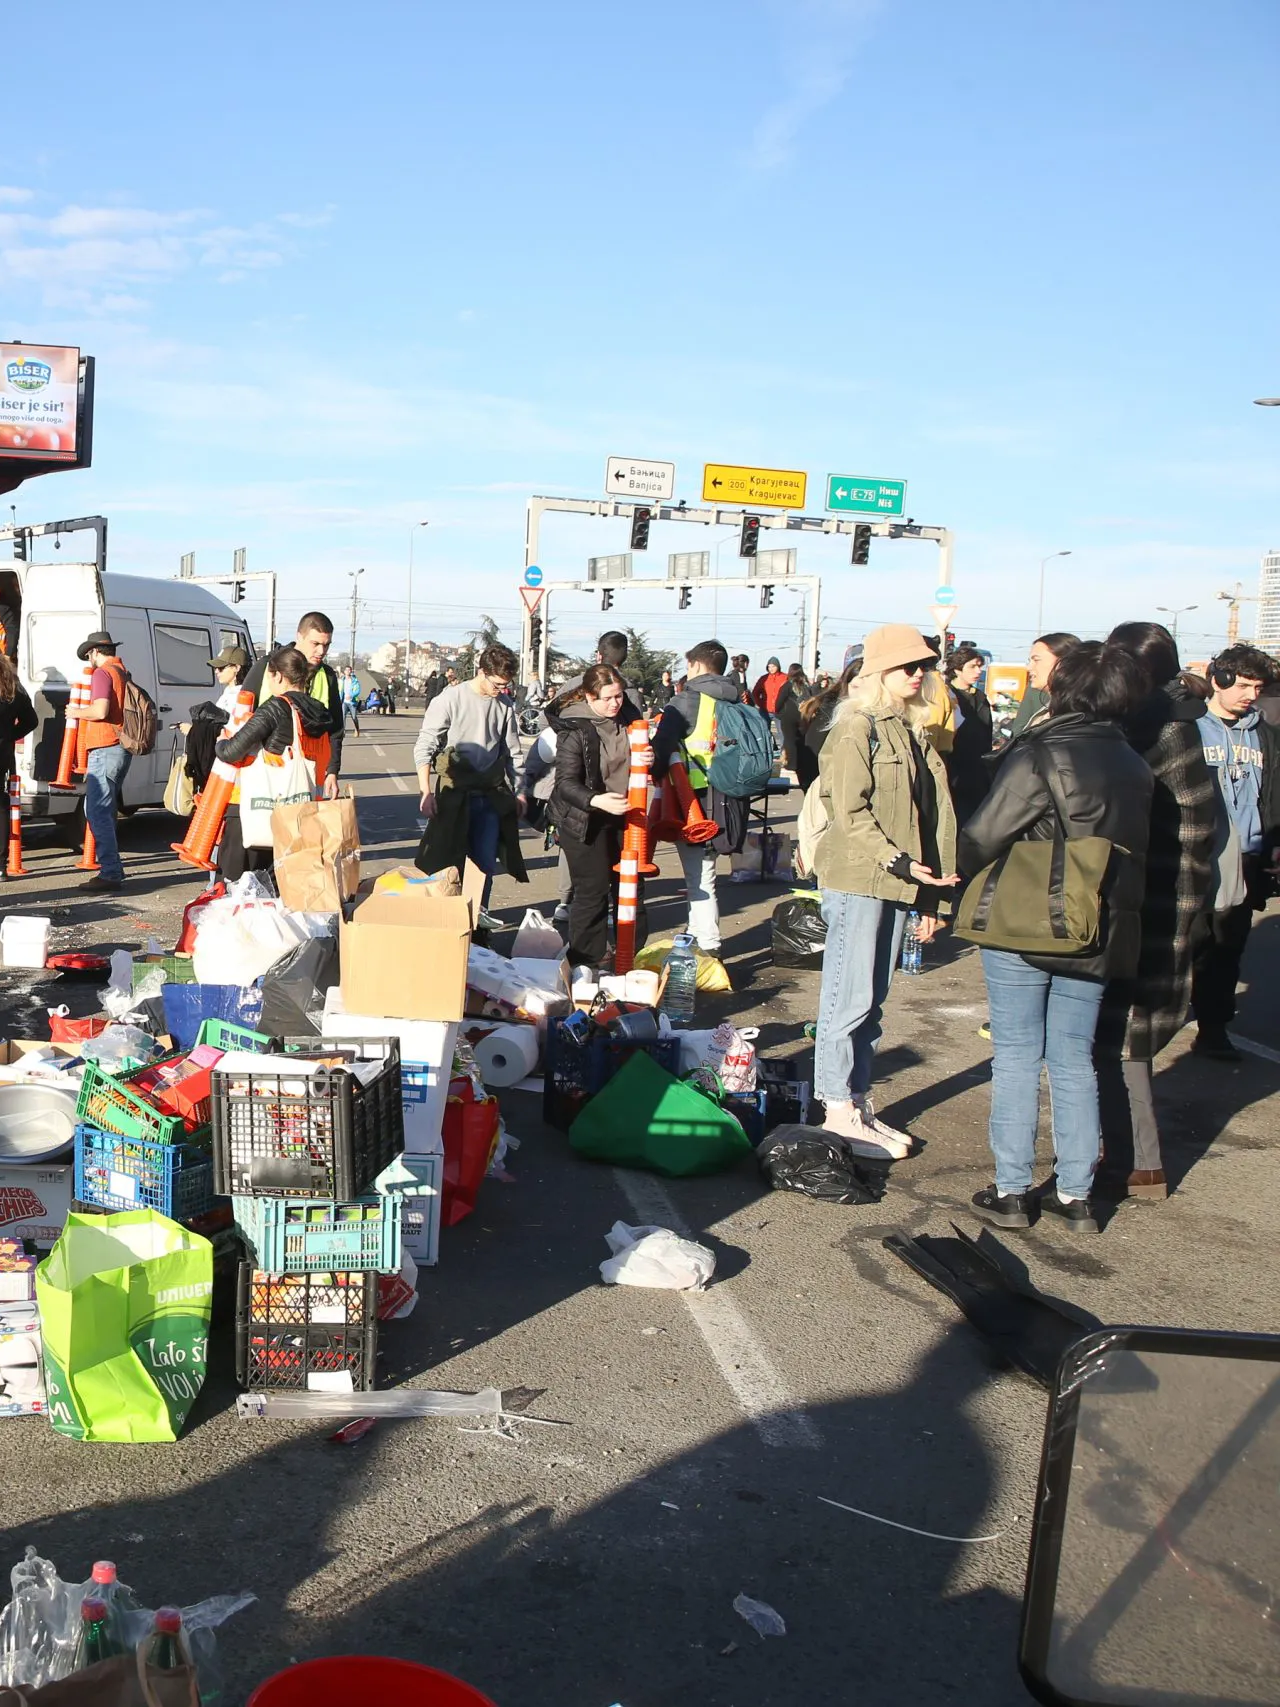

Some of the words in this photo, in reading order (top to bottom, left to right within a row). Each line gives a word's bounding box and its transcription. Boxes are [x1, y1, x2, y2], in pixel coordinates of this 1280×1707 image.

[28, 399, 40, 413] je
[42, 400, 65, 412] sir!
[21, 413, 34, 421] više
[46, 416, 64, 424] toga.
[629, 466, 666, 479] Бањица
[628, 479, 663, 493] Banjica
[729, 481, 746, 490] 200
[750, 475, 800, 489] Крагујевац
[748, 489, 798, 502] Kragujevac
[852, 489, 874, 500] E-75
[879, 485, 899, 496] Ниш
[877, 496, 893, 508] Niš
[144, 1337, 186, 1368] Zato
